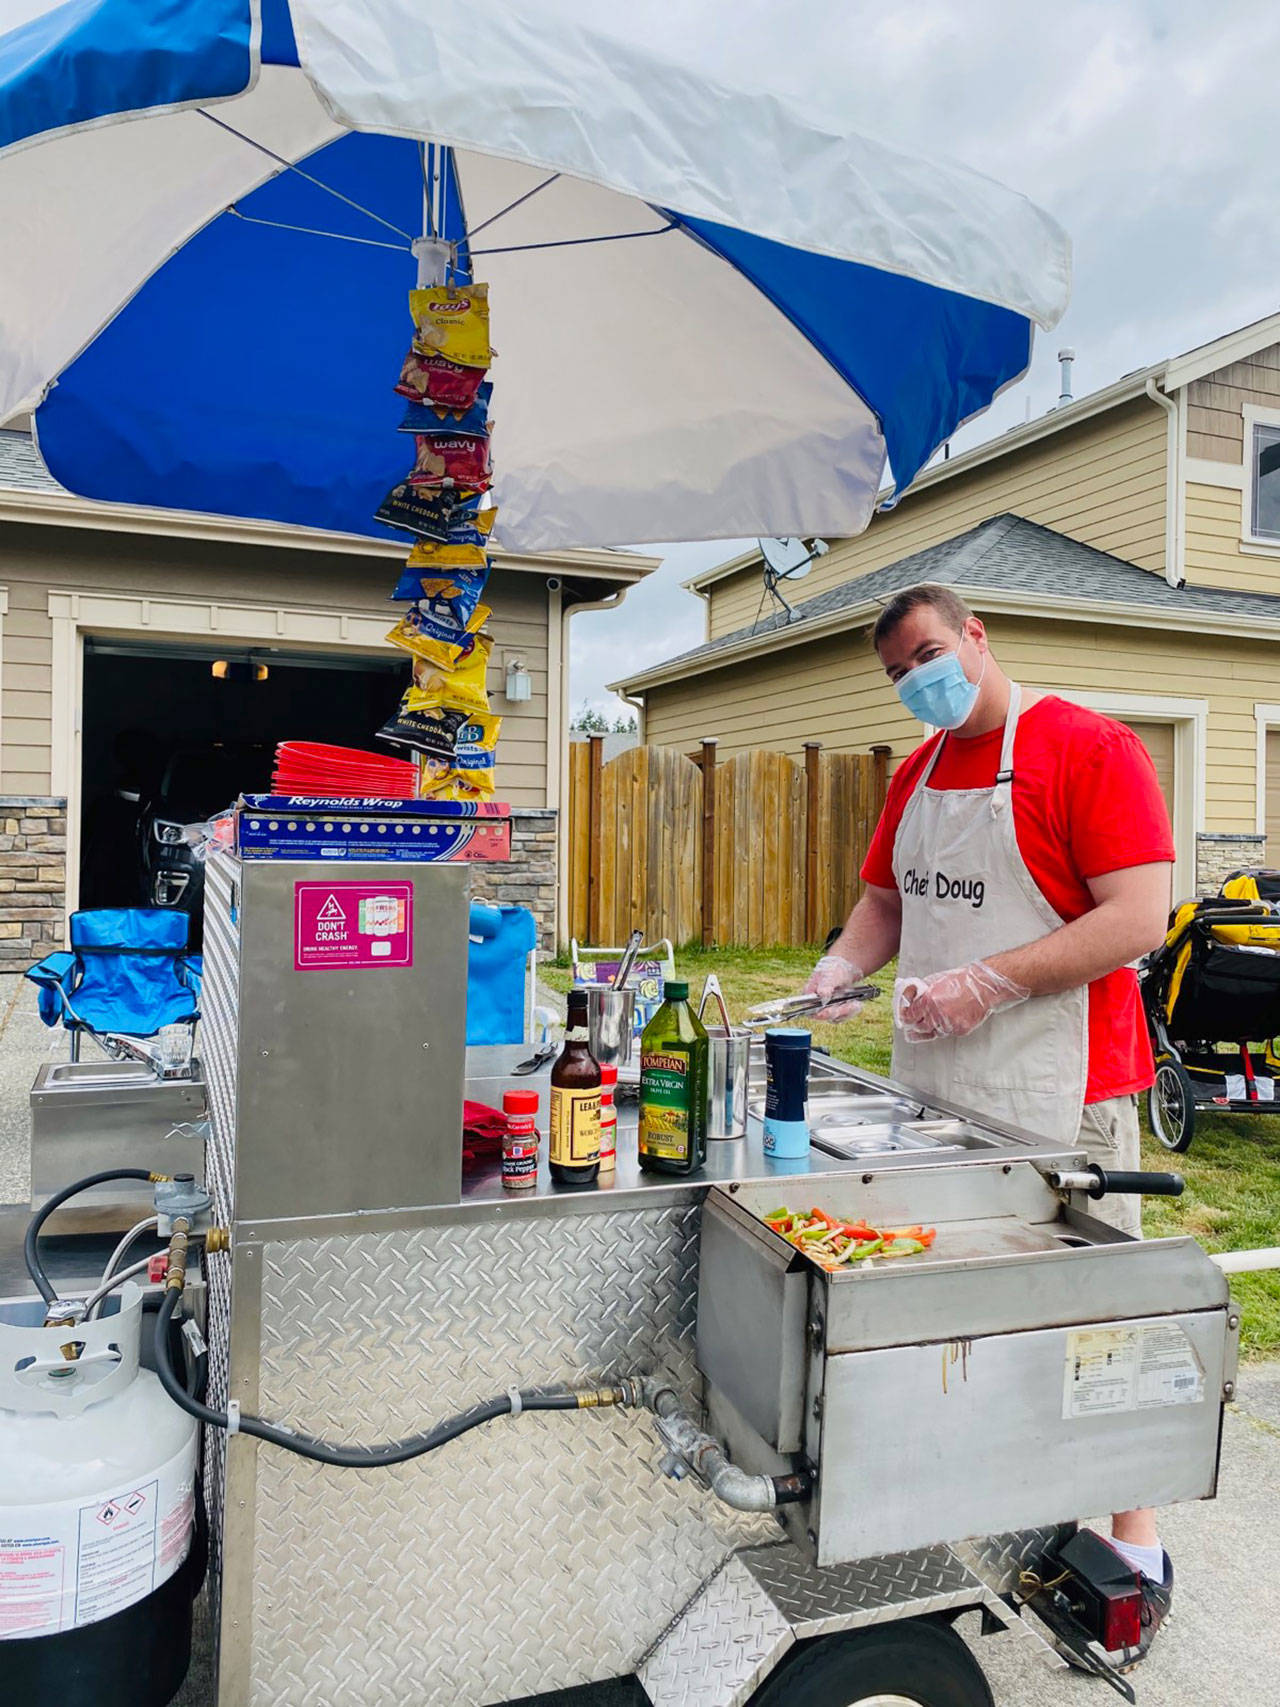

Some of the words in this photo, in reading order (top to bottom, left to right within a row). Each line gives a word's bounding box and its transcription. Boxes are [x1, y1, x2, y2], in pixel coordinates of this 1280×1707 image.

[436, 318, 465, 326] Classic
[434, 440, 476, 452] wavy
[392, 500, 412, 511] WHITE
[411, 503, 440, 520] CHEDDAR
[425, 623, 456, 641] Original
[397, 718, 416, 728] WHITE
[287, 796, 361, 808] Reynolds
[362, 798, 404, 809] Wrap
[936, 872, 985, 908] Doug
[318, 921, 346, 931] DON'T
[315, 931, 347, 942] CRASH
[643, 1056, 683, 1071] POMPEIAN
[642, 1077, 660, 1087] EXTRA
[660, 1079, 685, 1089] VIRGIN
[580, 1102, 593, 1112] LEA
[647, 1132, 674, 1143] ROBUST
